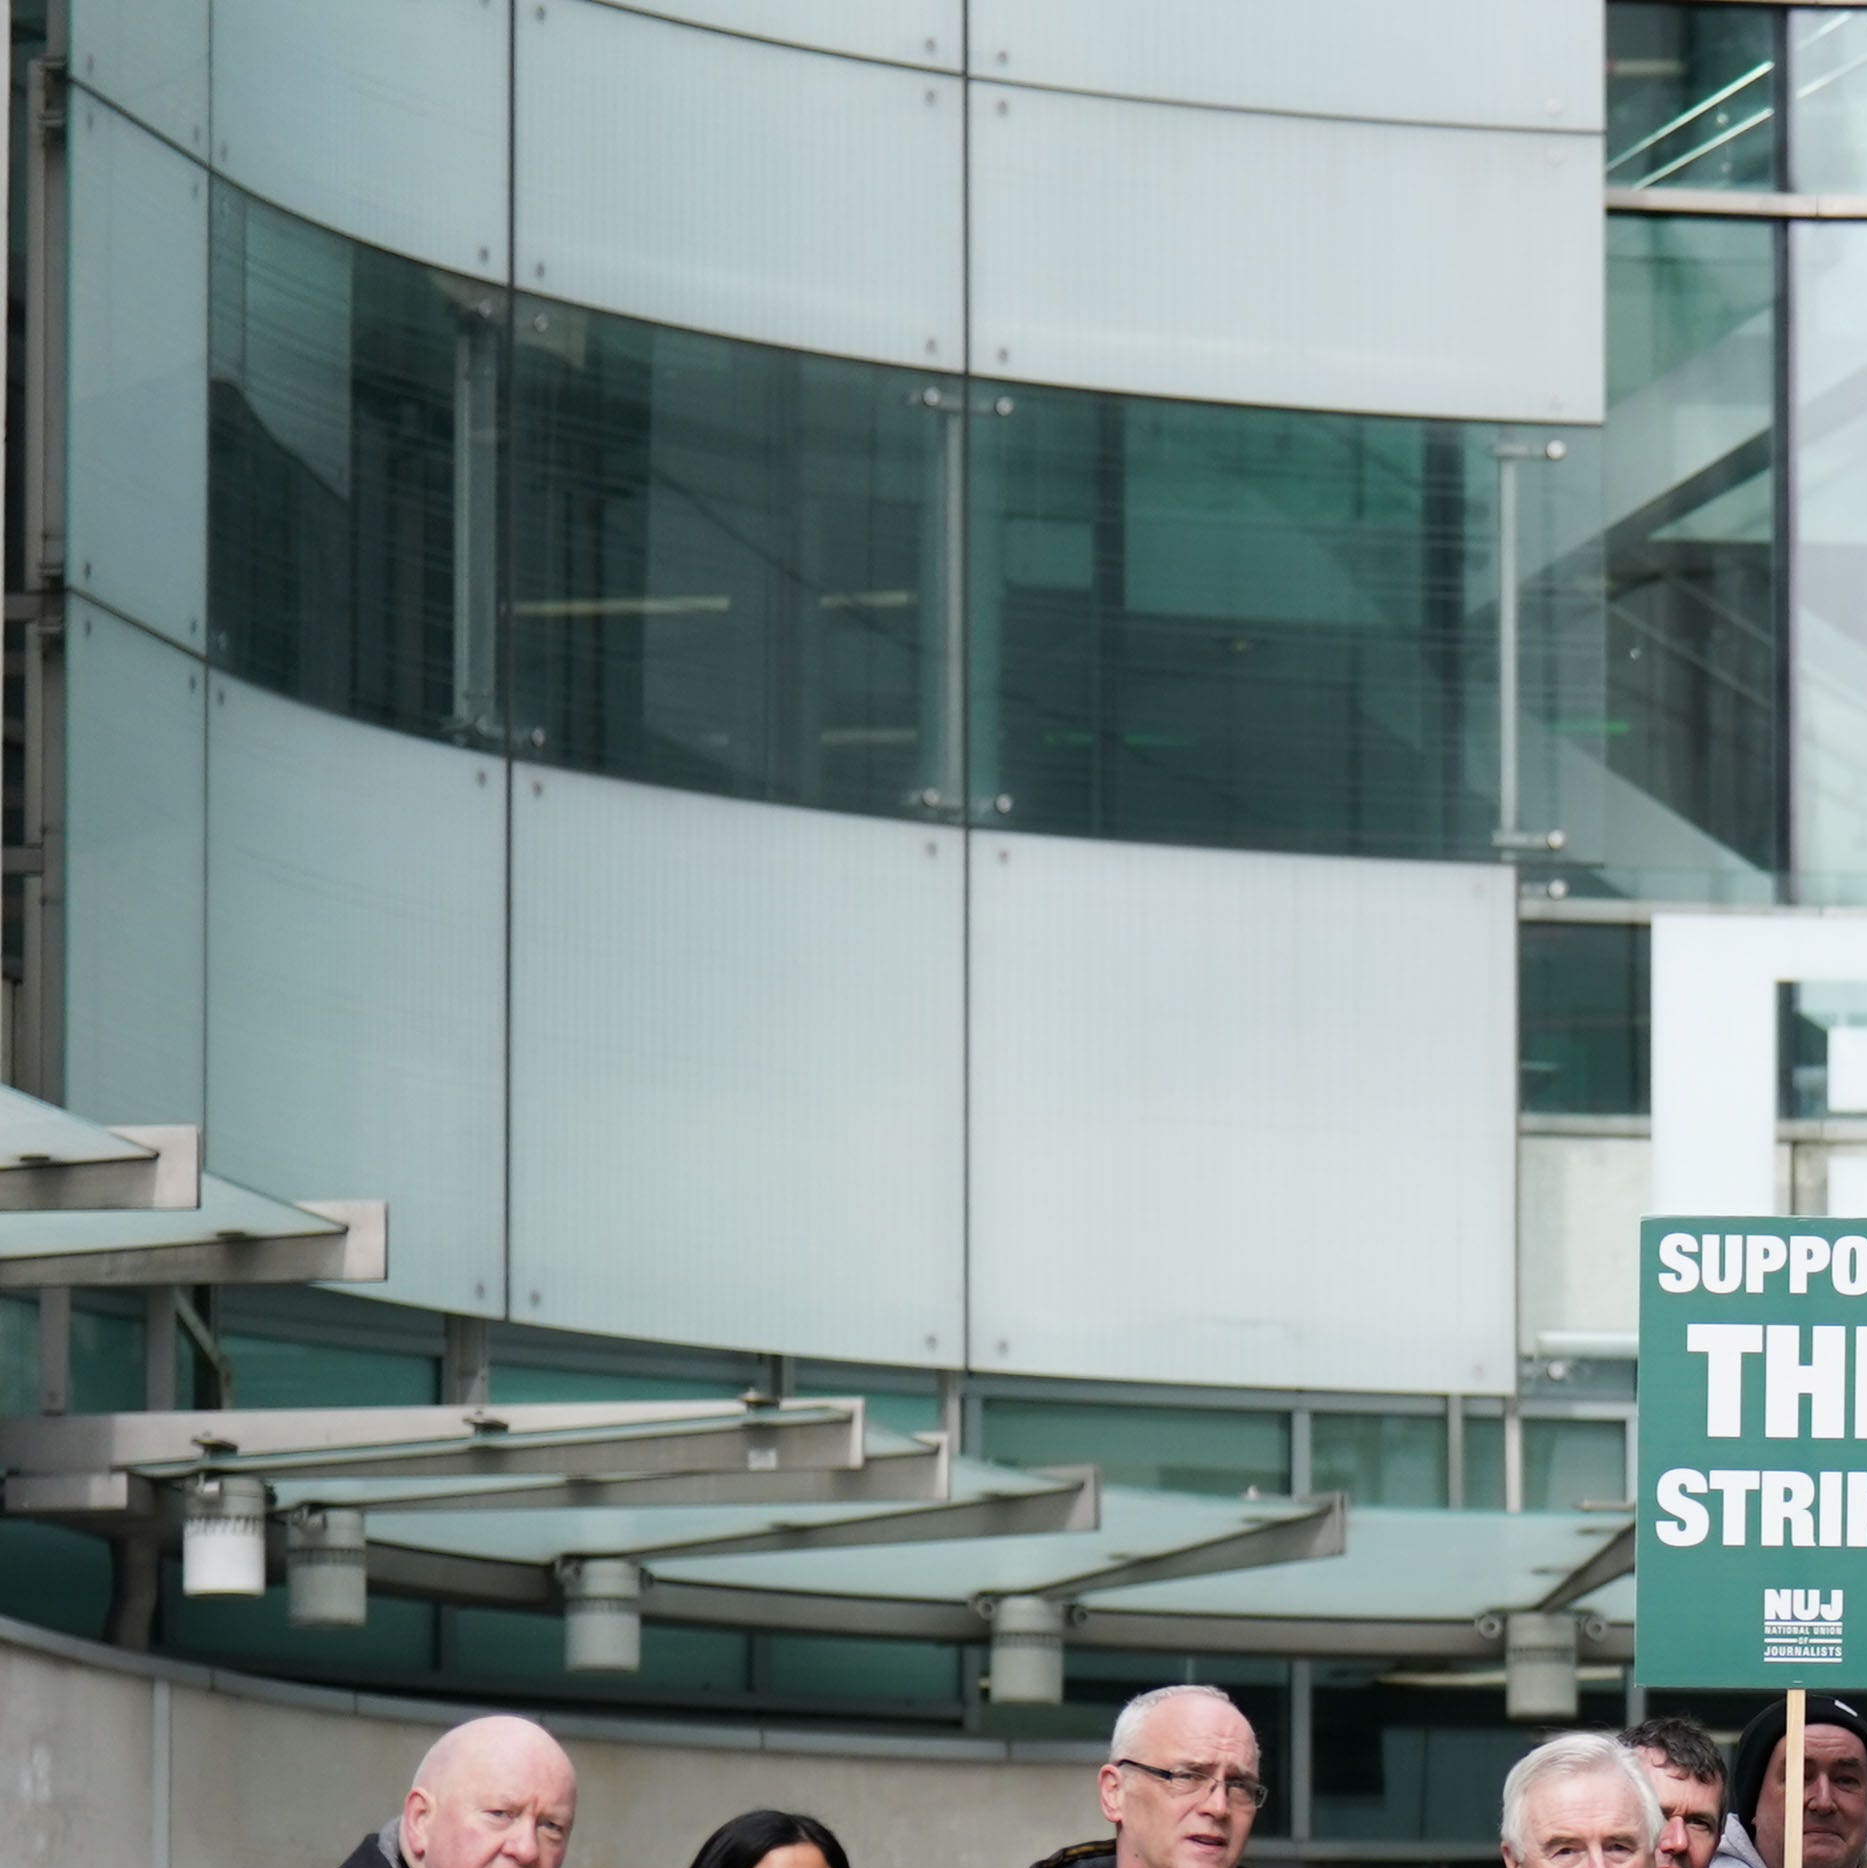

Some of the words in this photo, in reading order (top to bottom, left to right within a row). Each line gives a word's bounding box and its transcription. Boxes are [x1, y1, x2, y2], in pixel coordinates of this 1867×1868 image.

[1765, 1589, 1843, 1620] NUJ
[1765, 1626, 1810, 1635] NATIONAL
[1813, 1626, 1842, 1635] UNION
[1764, 1646, 1842, 1656] JOURNALISTS
